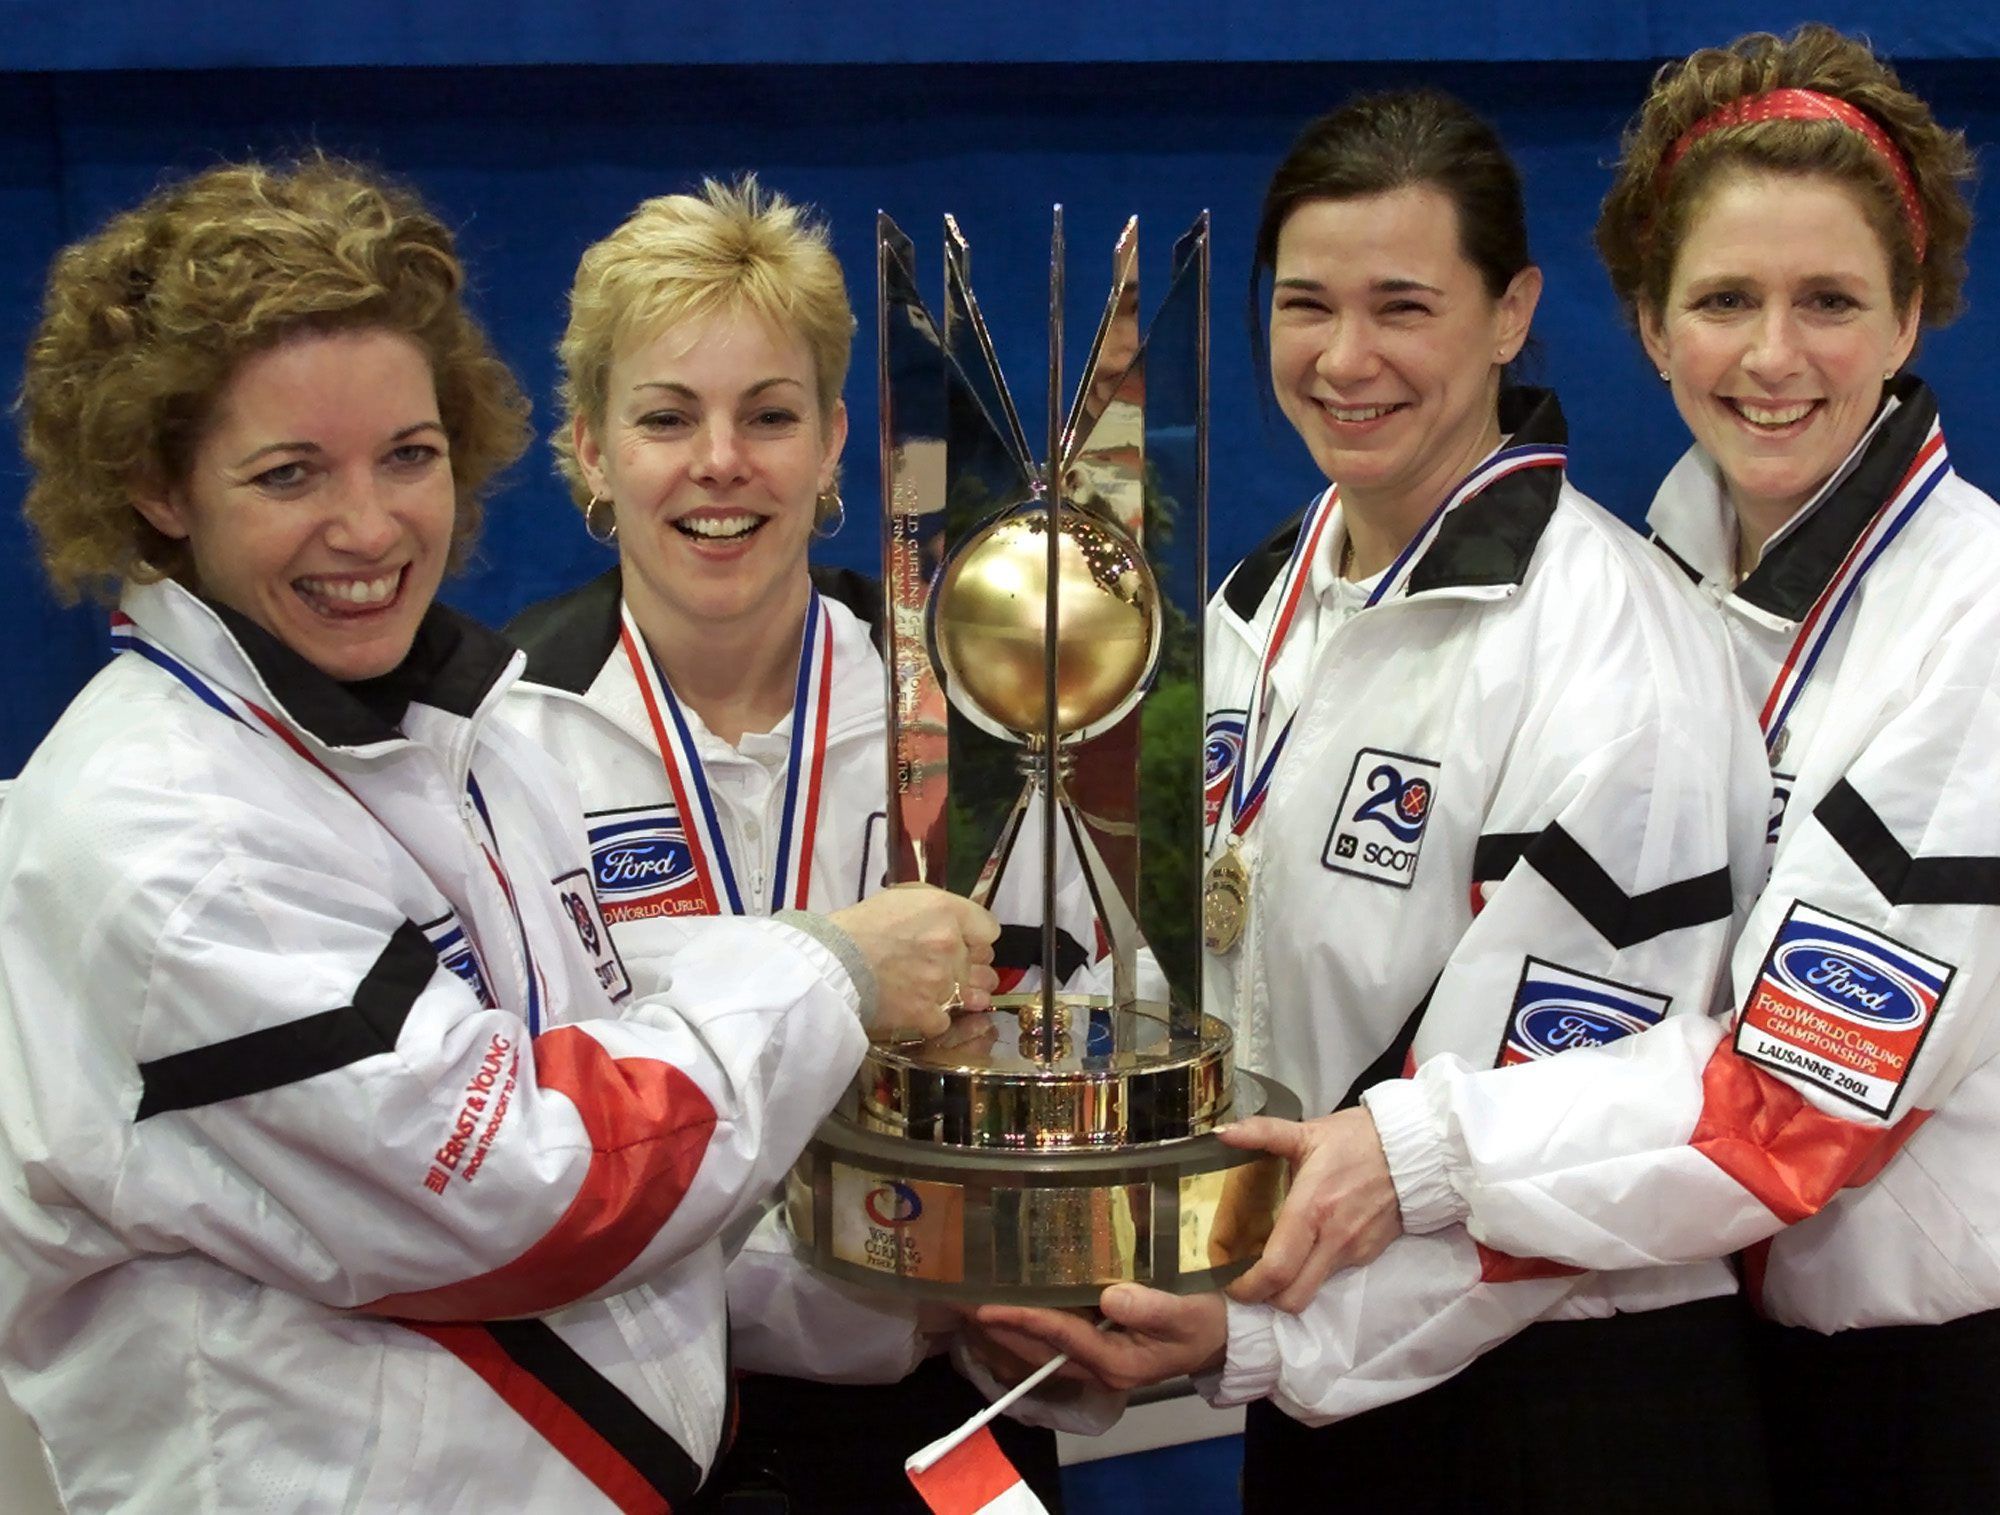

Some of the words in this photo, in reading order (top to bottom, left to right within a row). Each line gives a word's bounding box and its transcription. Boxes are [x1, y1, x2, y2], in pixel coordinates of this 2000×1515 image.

[1353, 765, 1431, 843] 20
[600, 846, 676, 883] Ford
[1806, 957, 1893, 1011] Ford
[1756, 992, 1795, 1019] FORD
[1793, 1004, 1845, 1041] WORLD
[1844, 1030, 1904, 1069] CURLING
[1766, 1017, 1878, 1074] CHAMPIONSHIPS
[466, 1033, 510, 1095] YOUNG
[1757, 1042, 1834, 1081] LAUSANNE
[1834, 1072, 1869, 1098] 2001
[466, 1096, 487, 1112] &
[435, 1107, 479, 1171] ERNST
